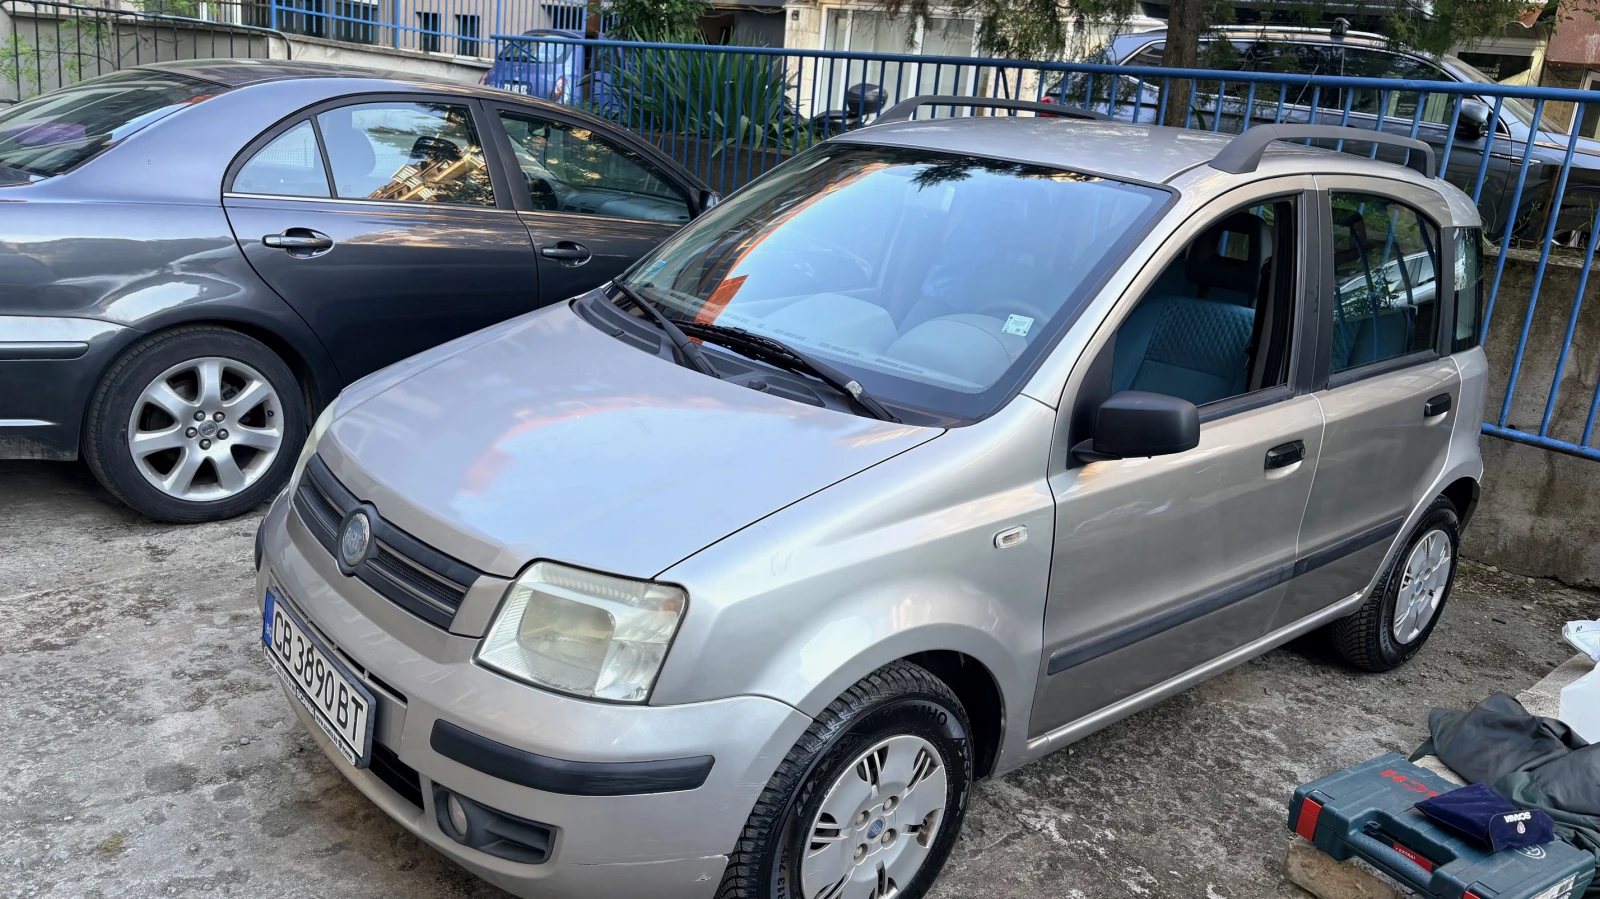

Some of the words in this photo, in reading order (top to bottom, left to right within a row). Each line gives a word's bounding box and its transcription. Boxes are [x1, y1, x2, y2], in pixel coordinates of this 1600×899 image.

[273, 610, 293, 663] CB
[294, 636, 335, 711] 3890
[336, 681, 363, 743] BT
[1503, 811, 1532, 823] SCANIA
